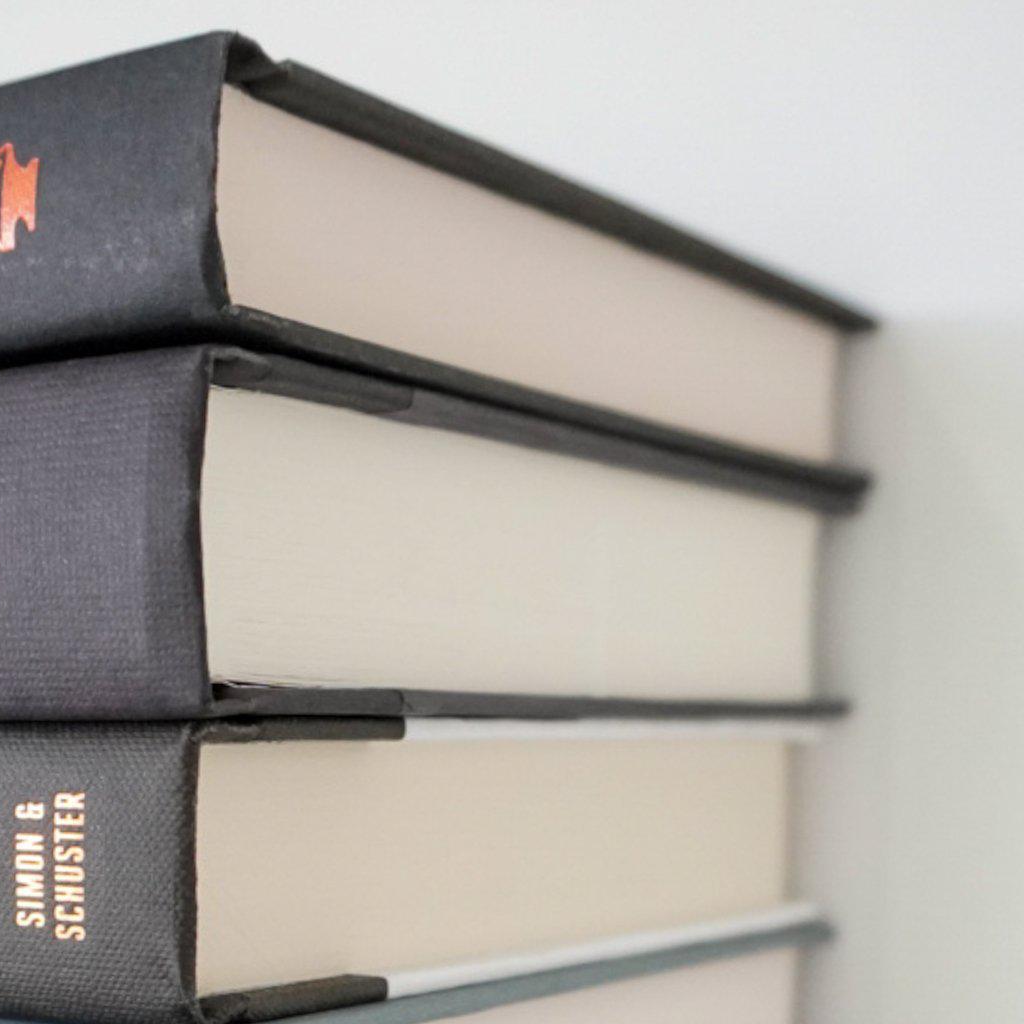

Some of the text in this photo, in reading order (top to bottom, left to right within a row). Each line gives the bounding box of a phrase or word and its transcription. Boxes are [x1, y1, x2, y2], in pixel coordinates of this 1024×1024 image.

[14, 801, 45, 929] SIMON &
[54, 792, 86, 942] SCHUSTER
